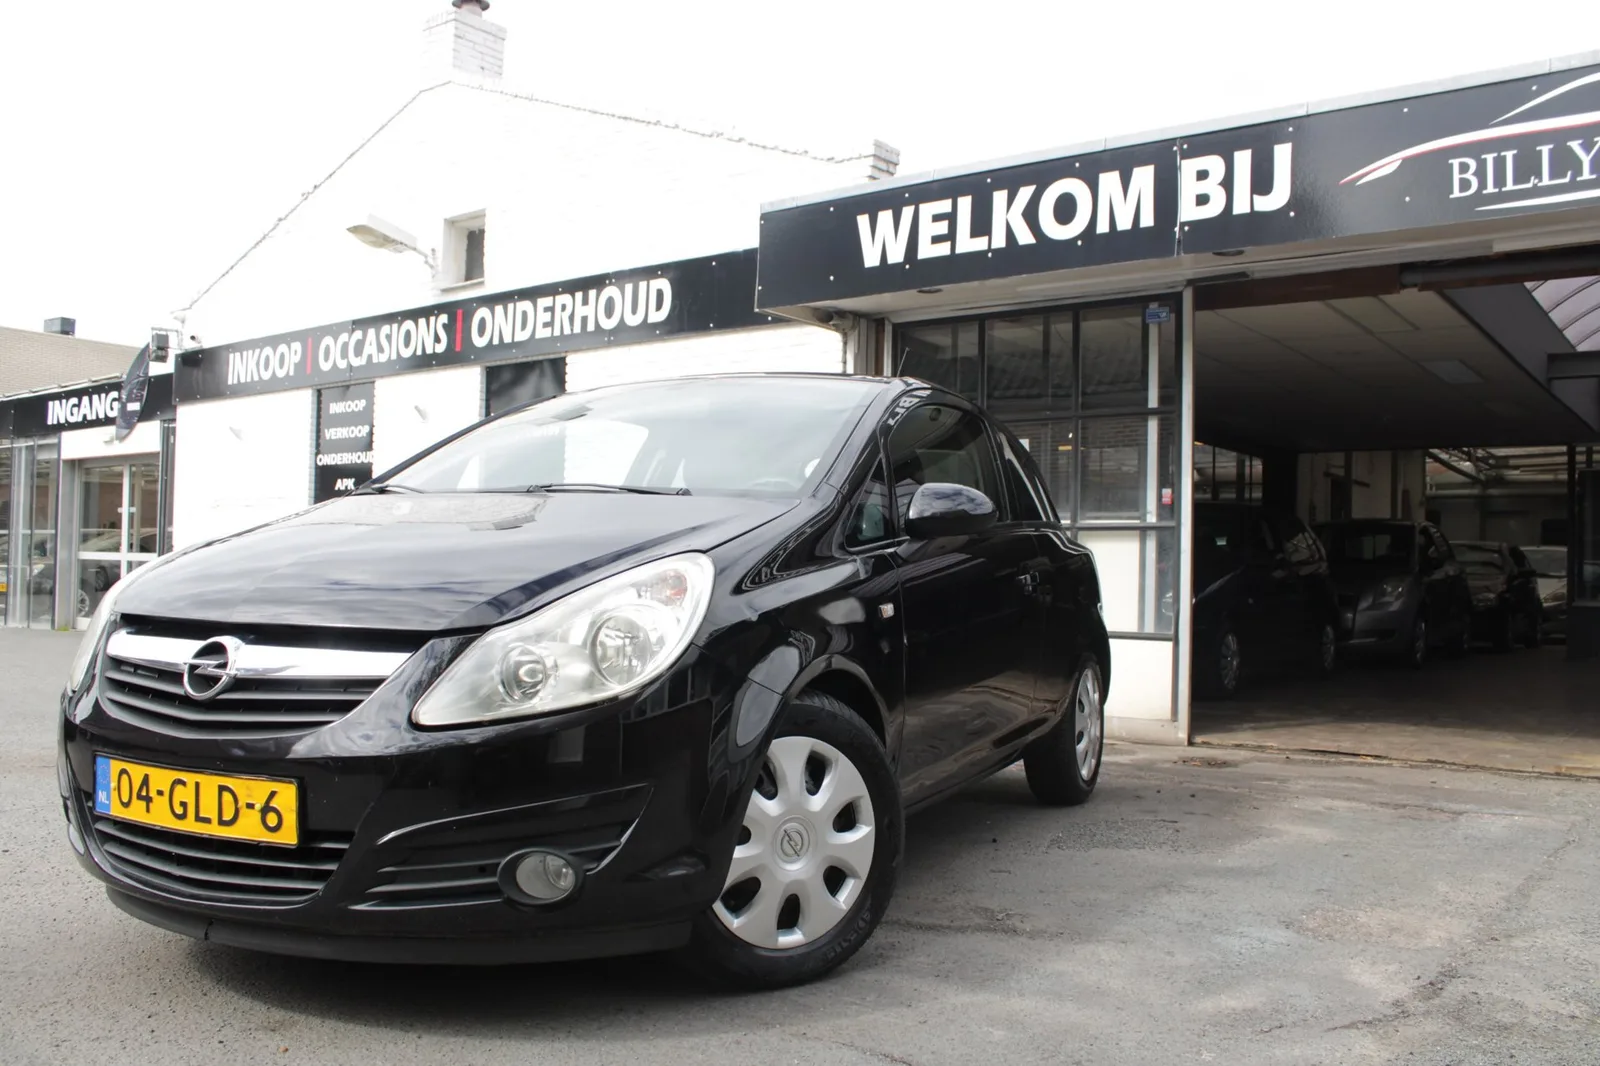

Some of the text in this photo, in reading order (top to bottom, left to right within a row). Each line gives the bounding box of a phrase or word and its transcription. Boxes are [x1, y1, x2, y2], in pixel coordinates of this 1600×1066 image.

[857, 142, 1293, 269] WELKOM BIJ
[227, 278, 672, 385] INKOOP OCCASIONS ONDERHOUD
[47, 391, 119, 425] INGANG
[329, 400, 367, 414] INKOOP
[324, 425, 370, 440] VERKOOP
[334, 478, 356, 490] APK
[98, 790, 110, 804] NL
[117, 768, 283, 833] 04-GLD-6
